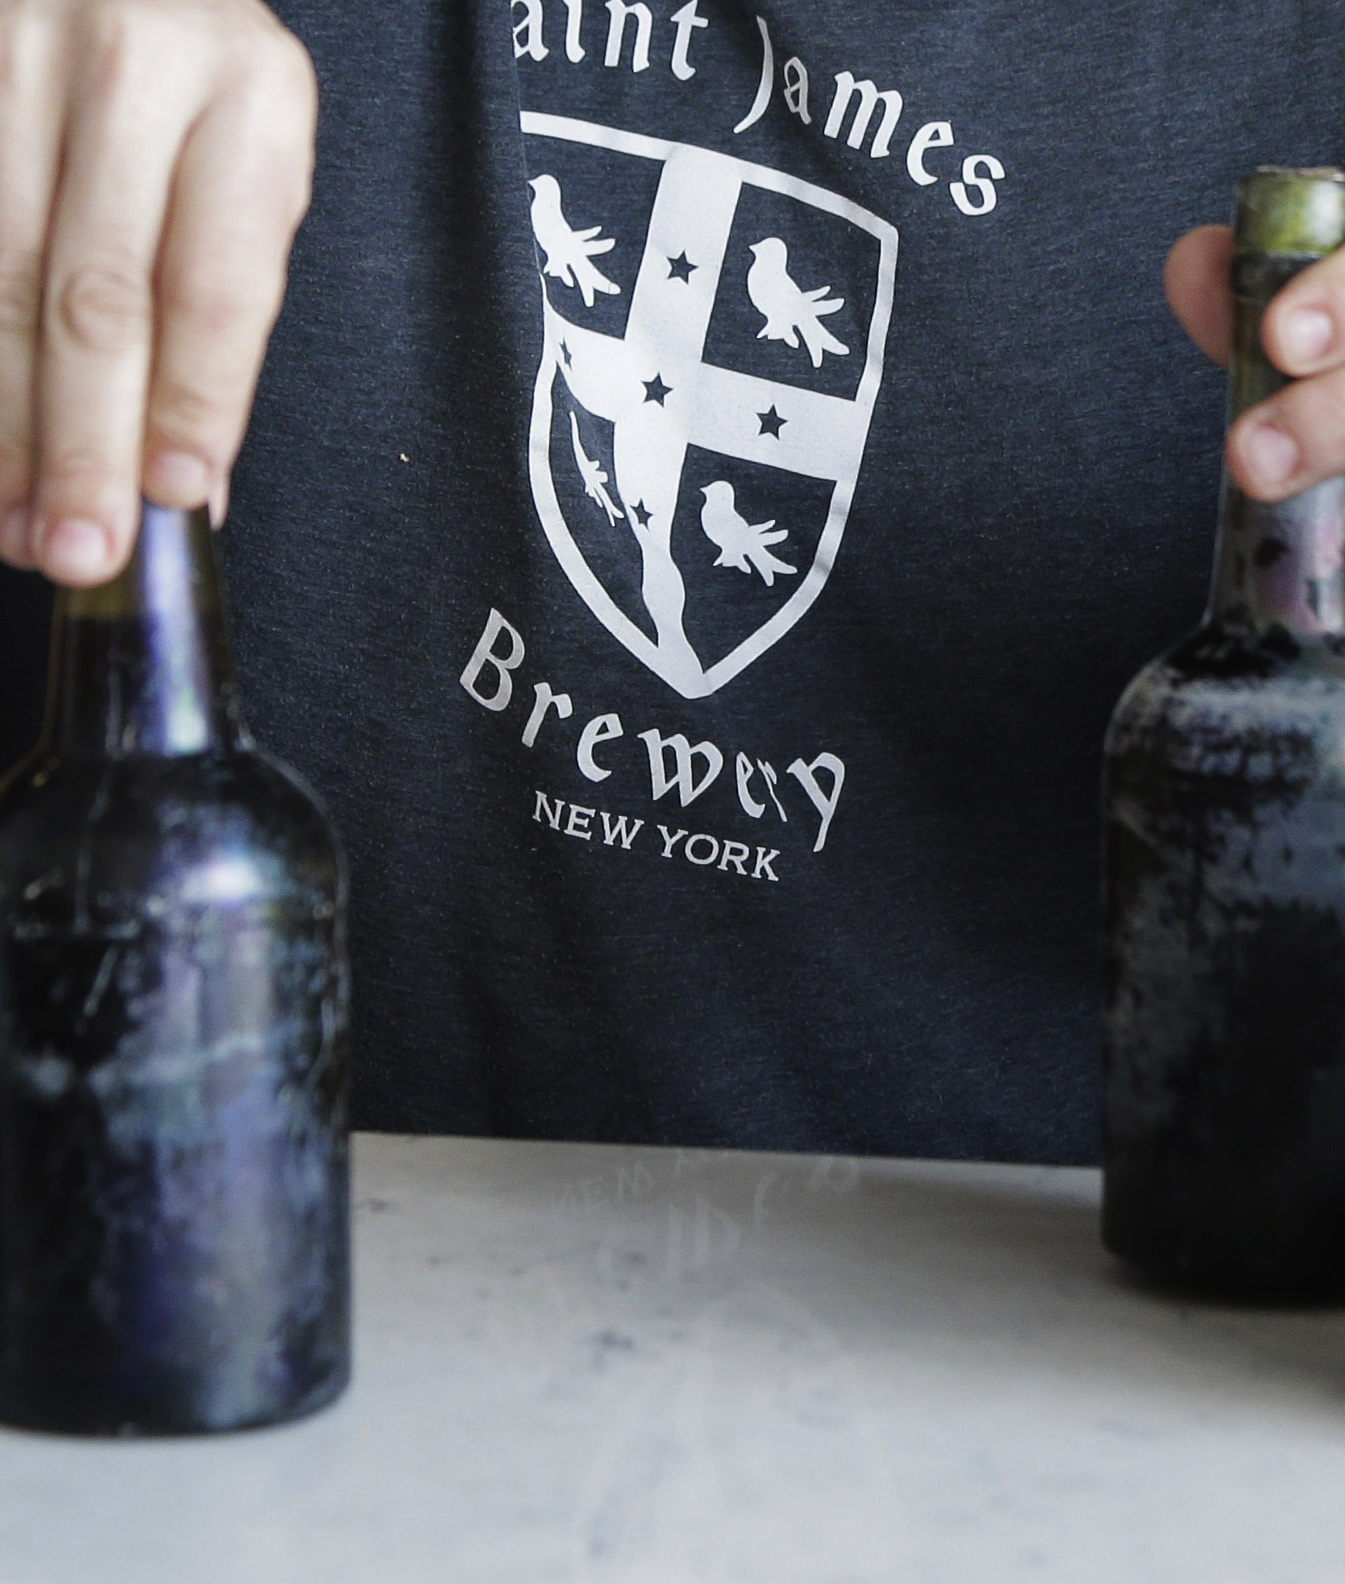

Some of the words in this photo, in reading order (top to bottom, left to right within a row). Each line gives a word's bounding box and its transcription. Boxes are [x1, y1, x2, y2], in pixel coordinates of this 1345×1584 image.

[733, 15, 1006, 216] James
[459, 607, 846, 853] Brewery
[531, 790, 645, 850] NEW
[656, 824, 781, 882] YORK
